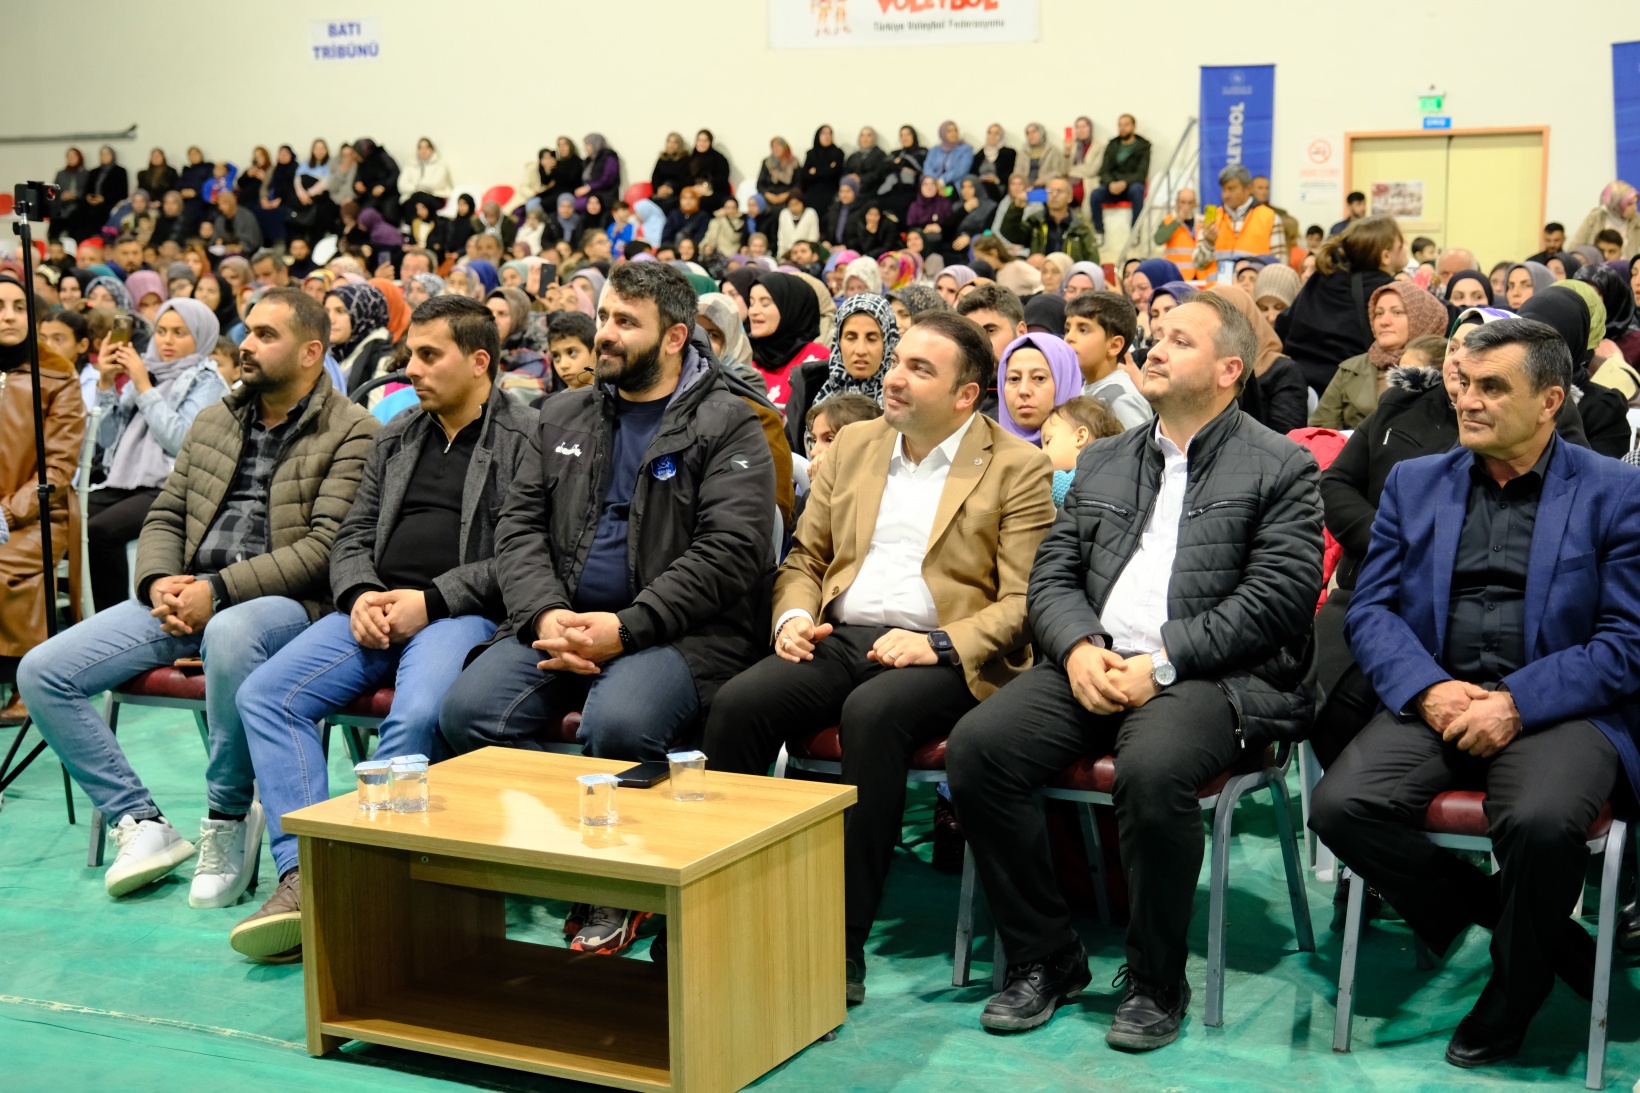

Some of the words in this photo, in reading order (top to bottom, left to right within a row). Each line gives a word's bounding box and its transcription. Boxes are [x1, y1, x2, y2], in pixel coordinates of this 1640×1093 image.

[329, 23, 361, 37] BATI
[873, 21, 904, 32] Türkiye
[907, 20, 945, 32] Voleybol
[948, 19, 1005, 30] Federasyonu
[313, 41, 379, 59] TRİBÜNÜ
[1226, 102, 1245, 164] LEYBOL
